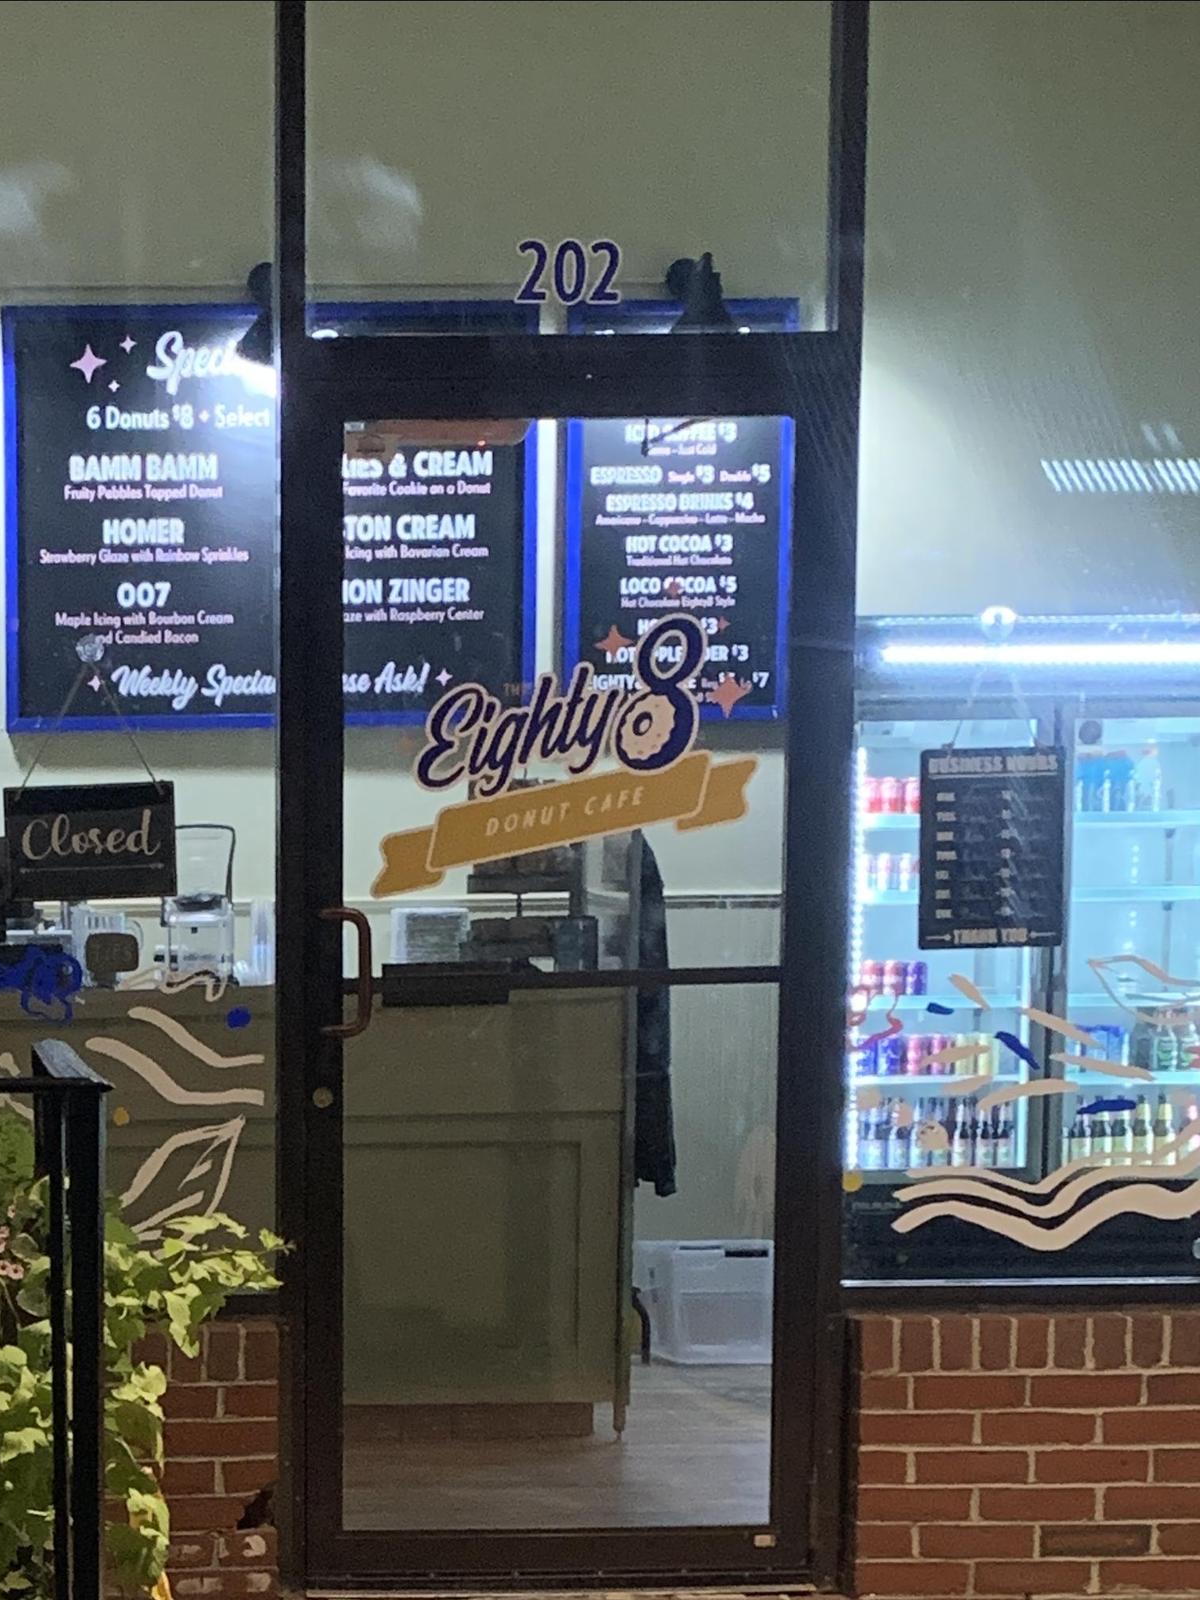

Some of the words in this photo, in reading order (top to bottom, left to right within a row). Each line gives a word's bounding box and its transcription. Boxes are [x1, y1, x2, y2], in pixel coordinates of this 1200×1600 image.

[514, 239, 621, 305] 202
[86, 406, 100, 429] 6
[105, 405, 170, 430] Donuts
[172, 404, 194, 429] $8
[214, 404, 271, 428] Select
[69, 455, 142, 481] BAMM
[146, 454, 218, 480] BAMM
[388, 452, 407, 478] &
[414, 451, 493, 477] CREAM
[590, 465, 663, 485] ESPRESSO
[63, 485, 95, 502] Fruity
[97, 485, 142, 500] Pebbles
[145, 484, 187, 502] Topped
[189, 484, 223, 499] Donut
[388, 480, 427, 496] Cookie
[430, 484, 444, 495] on
[447, 484, 455, 495] a
[457, 480, 491, 495] Donut
[606, 493, 677, 512] ESPRESSO
[678, 492, 734, 511] DRINKS
[102, 518, 185, 545] HOMER
[396, 514, 475, 540] CREAM
[375, 545, 398, 559] with
[400, 545, 450, 559] Bavarian
[452, 544, 489, 558] Cream
[626, 535, 657, 553] HOT
[659, 534, 712, 552] COCOA
[715, 534, 733, 552] $3
[40, 549, 97, 566] Strawberry
[99, 549, 129, 563] Glaze
[131, 549, 153, 562] with
[201, 547, 249, 564] Sprinkles
[116, 582, 171, 608] 007
[388, 578, 471, 602] ZINGER
[620, 577, 661, 595] LOCO
[719, 576, 737, 593] $5
[55, 612, 91, 629] Maple
[94, 612, 121, 629] Icing
[123, 612, 146, 626] with
[149, 611, 195, 626] Bourbon
[197, 610, 234, 625] Cream
[364, 608, 388, 621] with
[389, 607, 445, 624] Raspberry
[447, 606, 485, 621] Center
[95, 631, 112, 645] nd
[115, 631, 162, 645] Candied
[164, 630, 199, 644] Bacon
[732, 644, 749, 661] $3
[111, 665, 199, 711] Weekly
[374, 661, 431, 694] Ask!
[752, 672, 770, 688] $7
[485, 803, 569, 836] DONUT
[583, 785, 645, 817] CAFE
[22, 809, 160, 861] Closed
